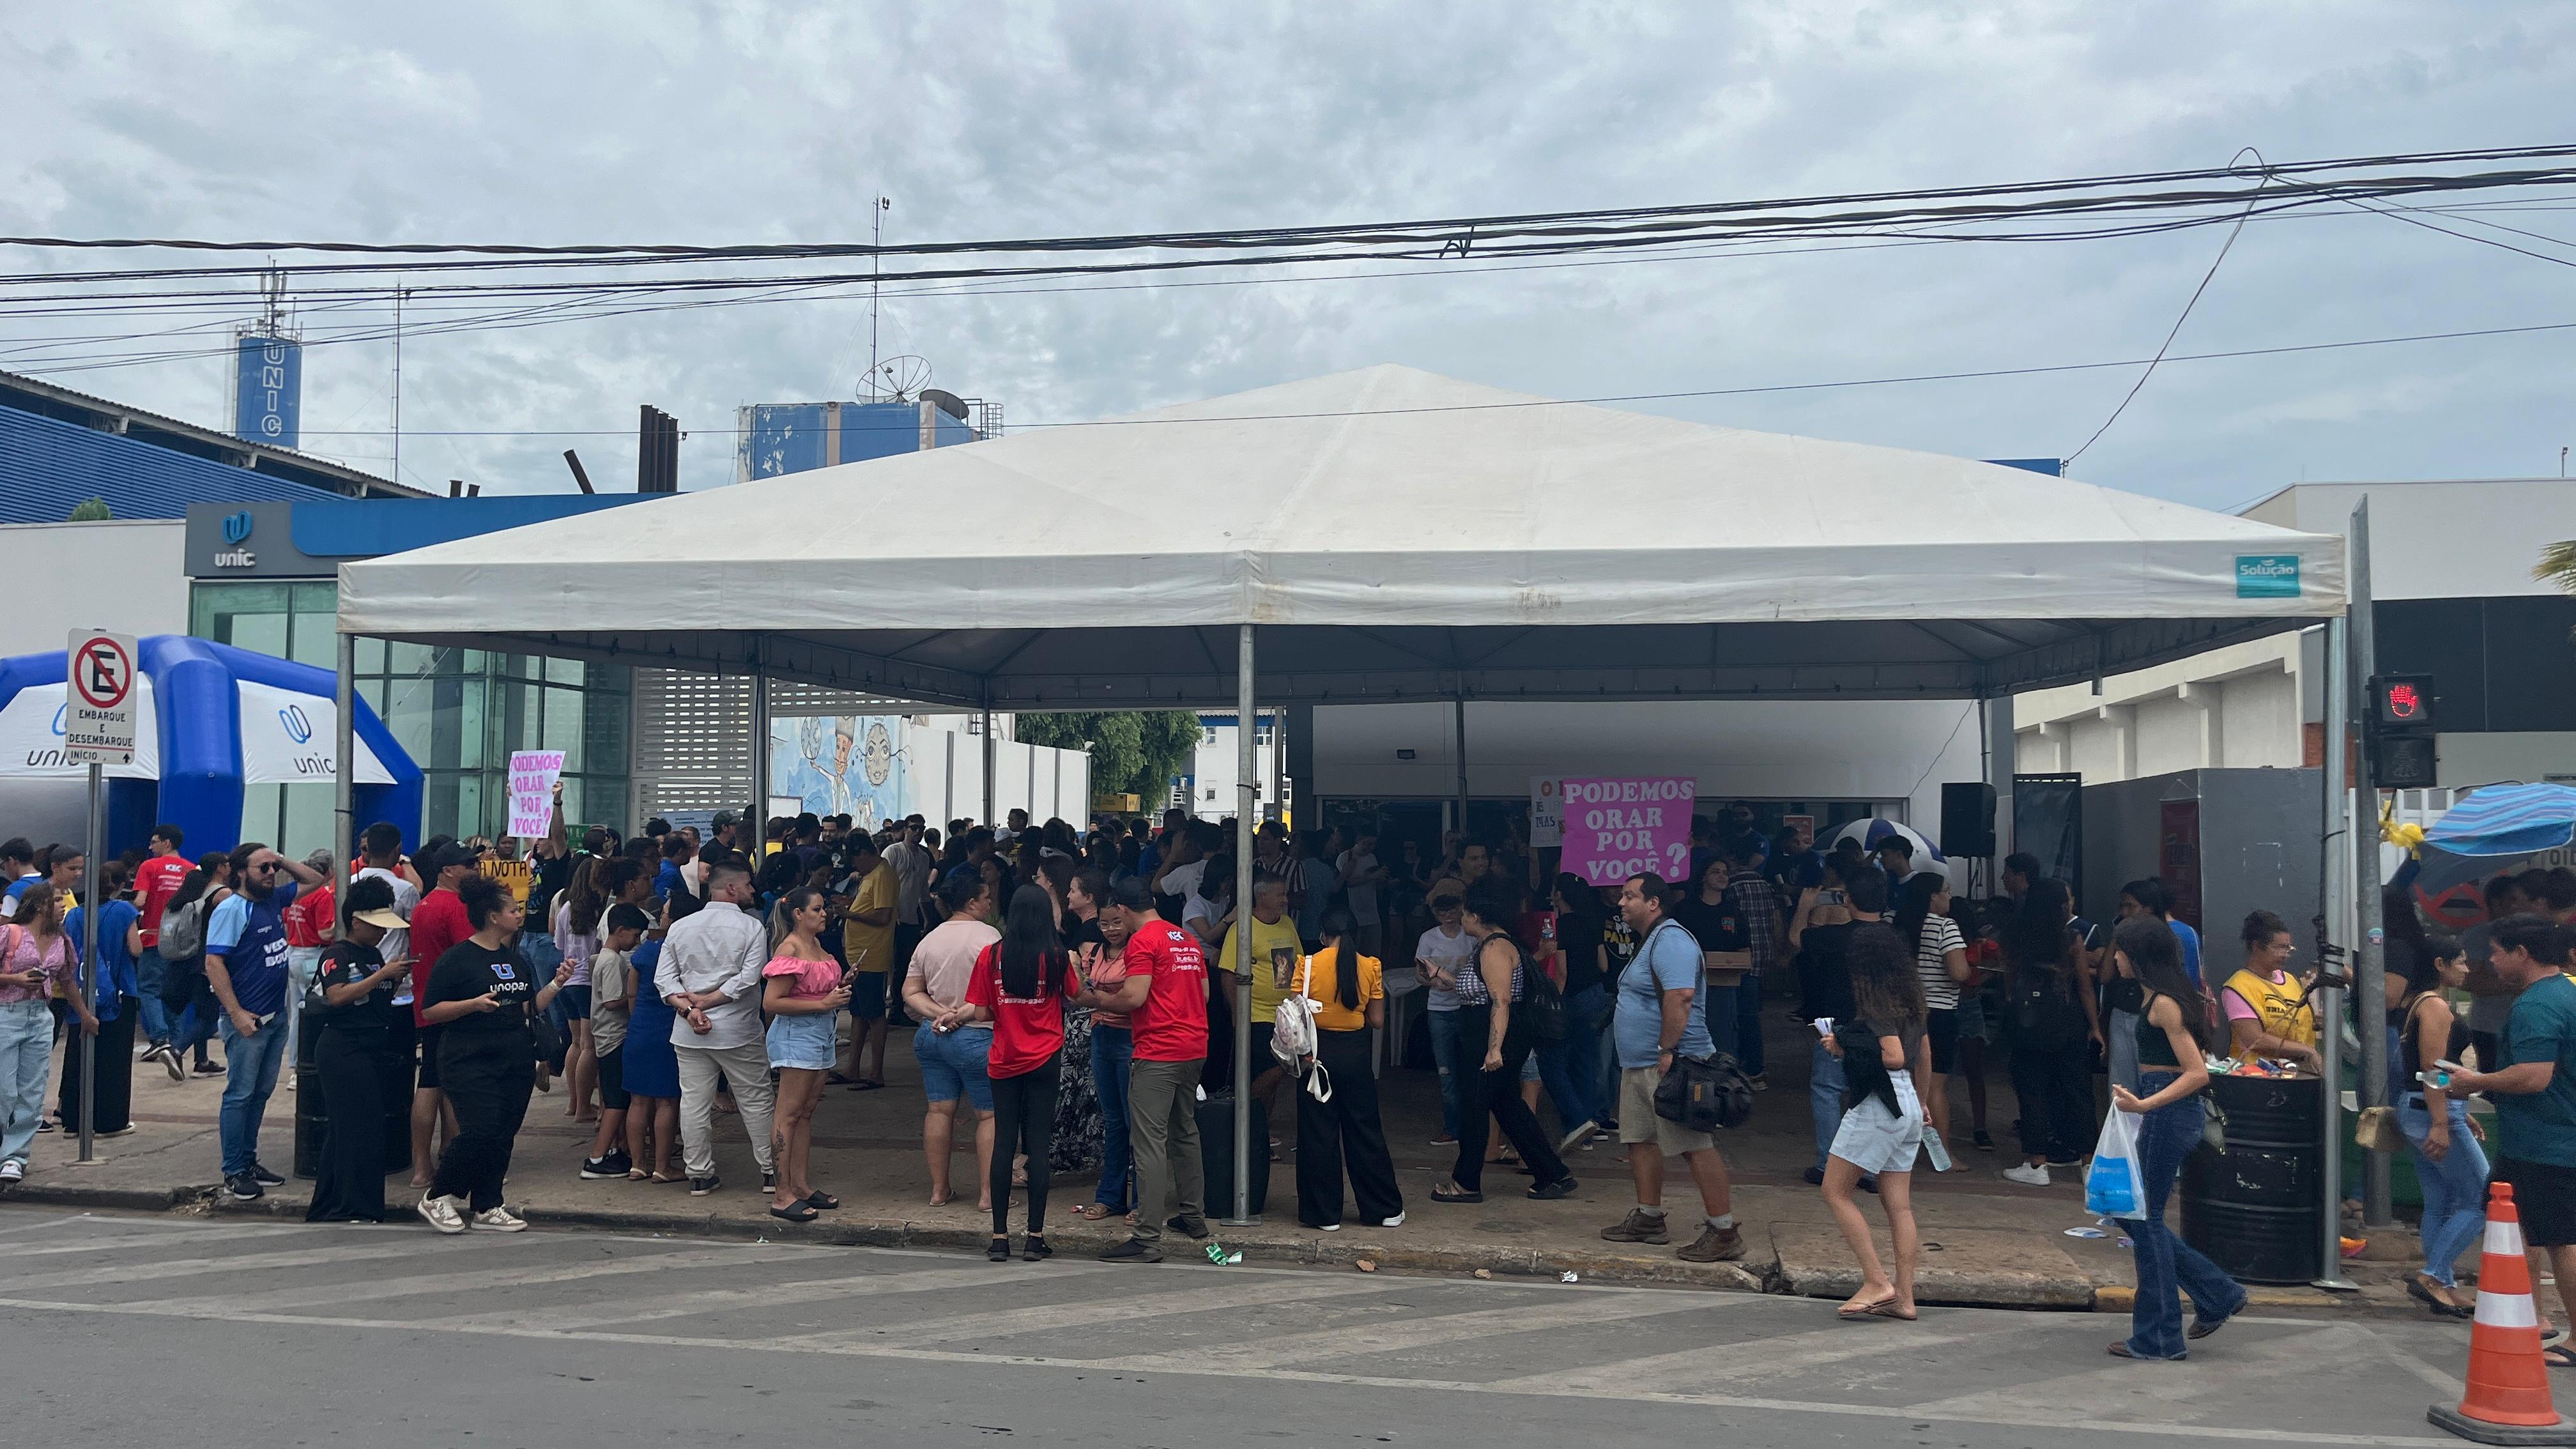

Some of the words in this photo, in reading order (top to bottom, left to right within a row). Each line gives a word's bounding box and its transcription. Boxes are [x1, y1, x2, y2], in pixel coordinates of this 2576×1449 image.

[261, 342, 286, 438] UNIC
[214, 548, 256, 567] unic
[2239, 564, 2296, 578] Solução
[79, 709, 126, 723] EMBARQUE
[100, 724, 105, 733] E
[68, 733, 133, 747] DESEMBARQUE
[27, 749, 79, 767] uni
[70, 749, 98, 760] INÍCIO
[293, 752, 336, 774] unic
[515, 775, 545, 793] ORAR
[1564, 780, 1694, 804] PODEMOS
[520, 797, 542, 813] POR
[1585, 807, 1662, 830] ORAR
[1596, 830, 1653, 852] POR
[491, 861, 526, 877] NOTA
[489, 982, 529, 994] unopar
